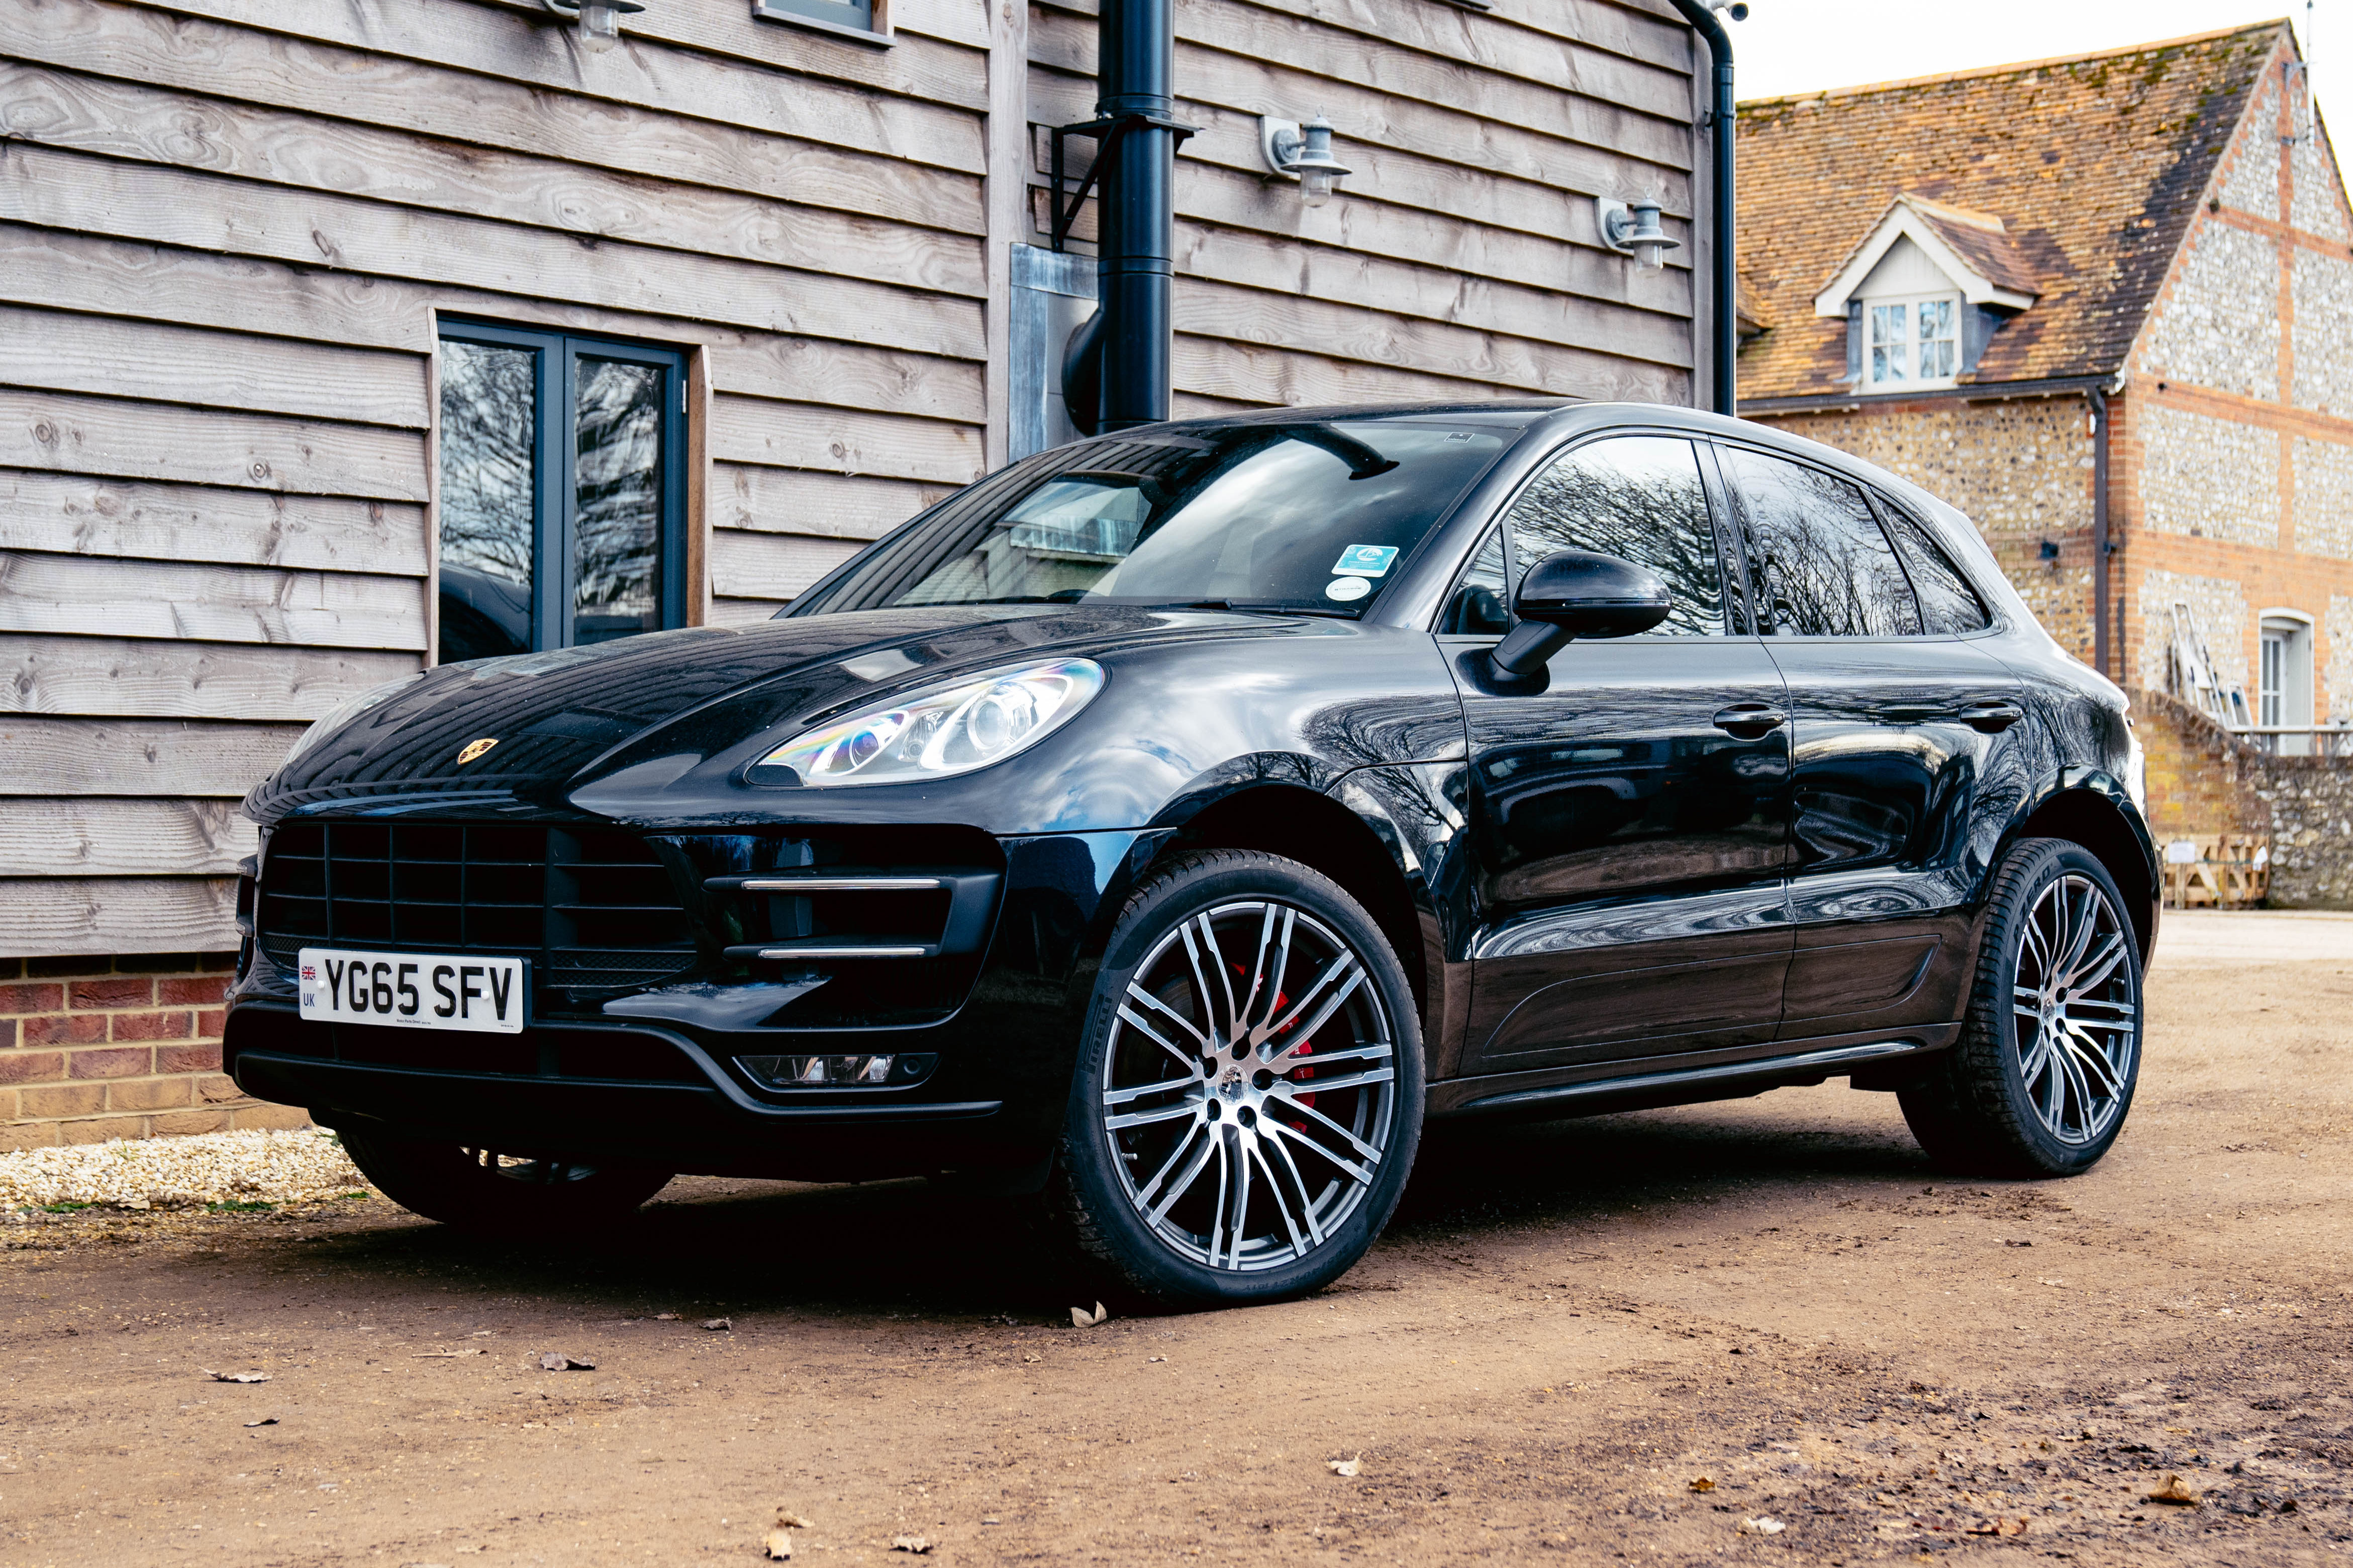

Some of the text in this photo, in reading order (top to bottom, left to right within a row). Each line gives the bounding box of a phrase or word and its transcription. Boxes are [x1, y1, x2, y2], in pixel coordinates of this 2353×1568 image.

[2020, 866, 2050, 922] ZERO
[303, 992, 315, 1007] UK
[325, 959, 513, 1021] YG65 SFV
[1081, 993, 1113, 1074] PIRELLI
